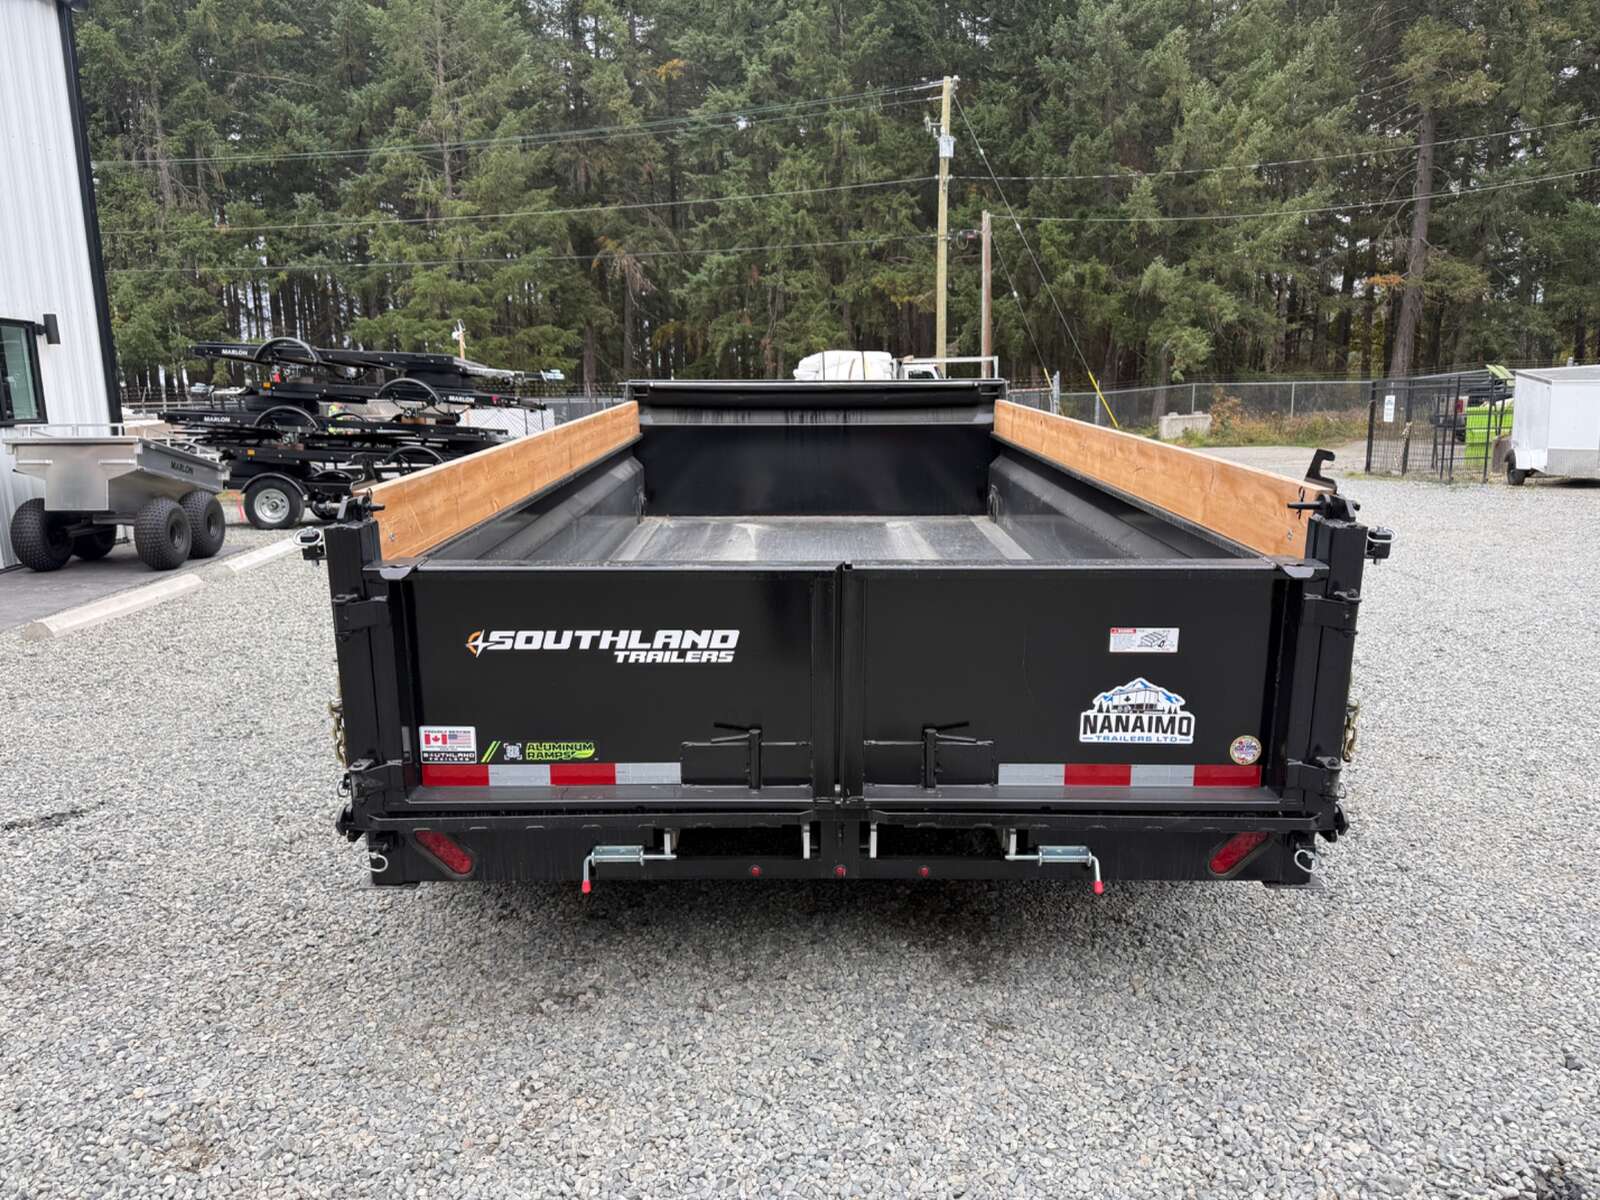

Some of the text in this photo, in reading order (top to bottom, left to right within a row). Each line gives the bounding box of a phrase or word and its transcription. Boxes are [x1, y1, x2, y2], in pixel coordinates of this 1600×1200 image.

[221, 348, 248, 356] MARLON
[489, 629, 741, 650] SOUTHLAND
[614, 650, 735, 663] TRAILERS
[1082, 714, 1193, 736] NANAIMO
[527, 743, 593, 751] ALUMINUM
[527, 751, 571, 759] RAMPS
